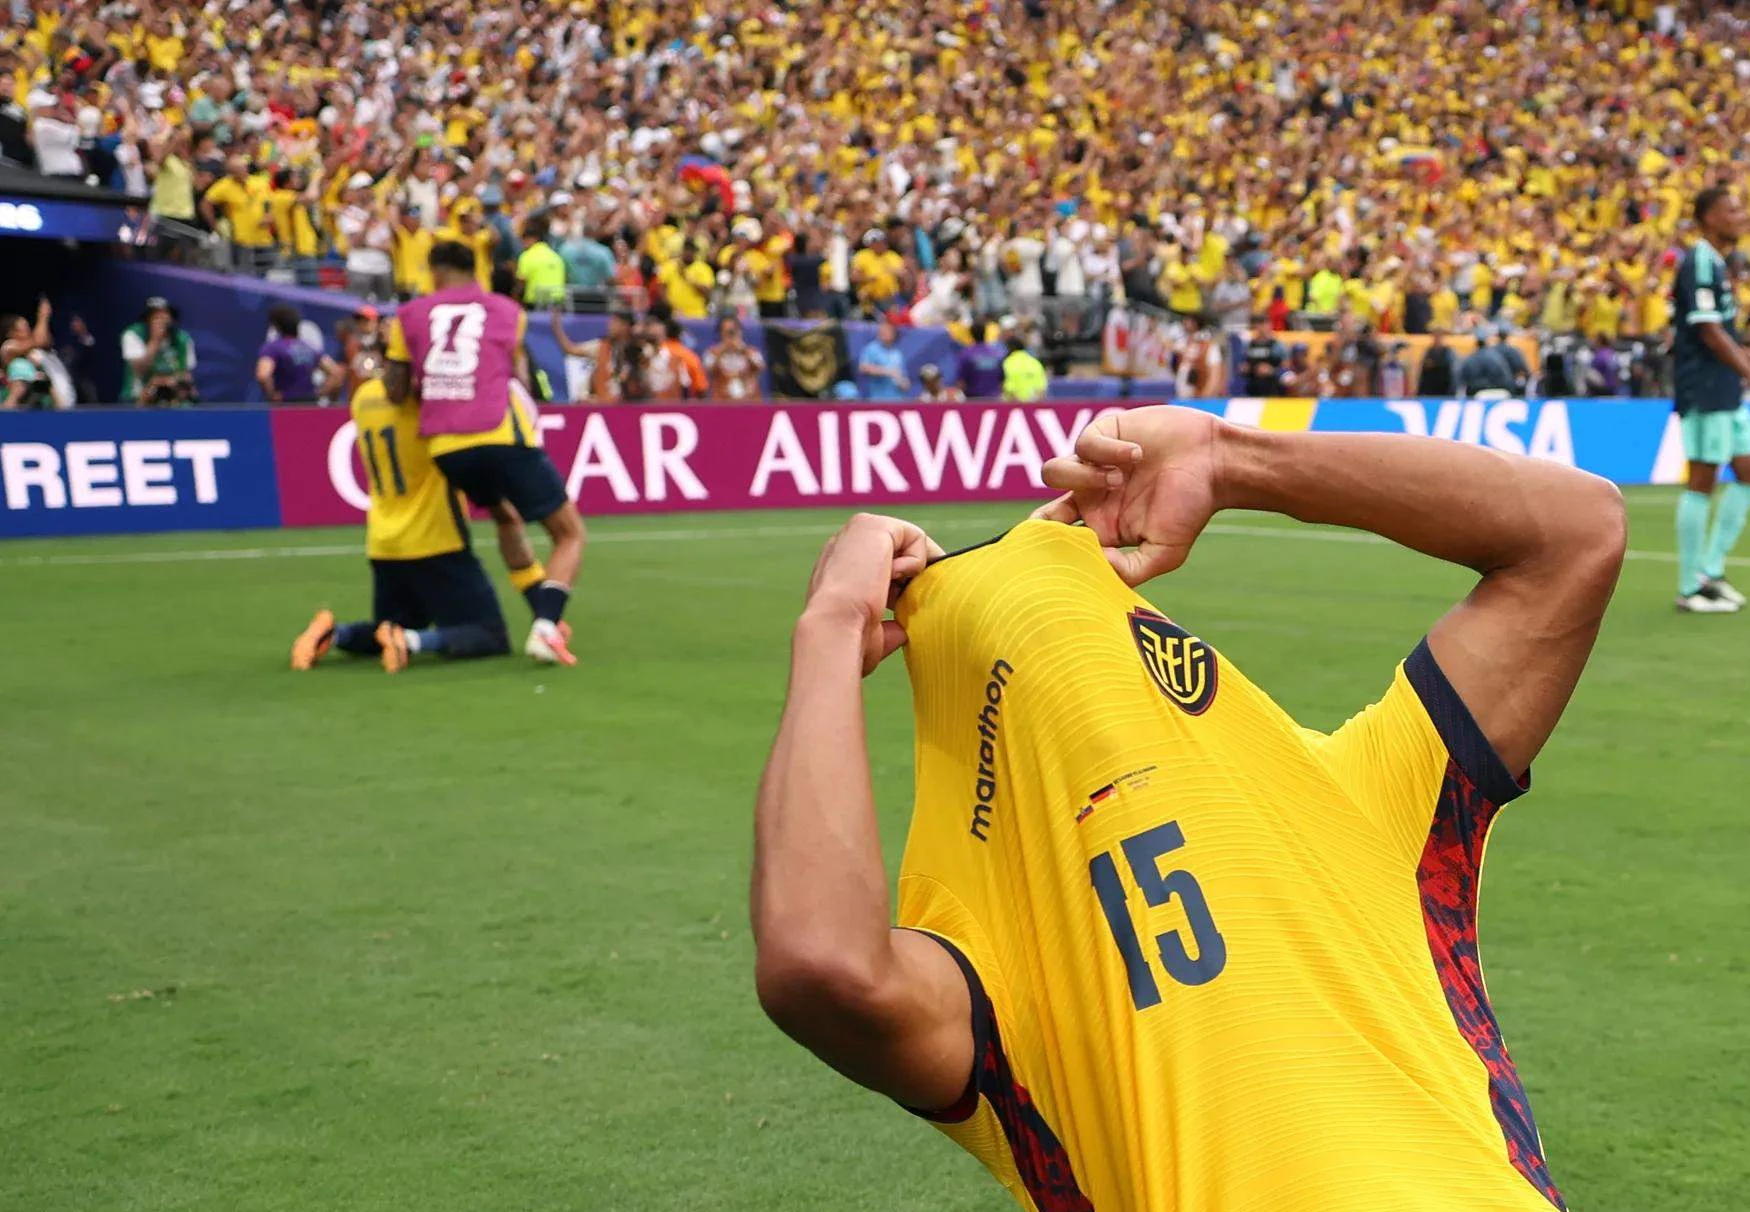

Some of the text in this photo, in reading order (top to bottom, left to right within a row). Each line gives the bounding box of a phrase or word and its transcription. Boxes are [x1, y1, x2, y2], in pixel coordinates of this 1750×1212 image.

[2, 439, 230, 509] REET
[363, 425, 408, 497] 11
[970, 658, 1014, 842] marathon
[1088, 819, 1228, 1011] 15
